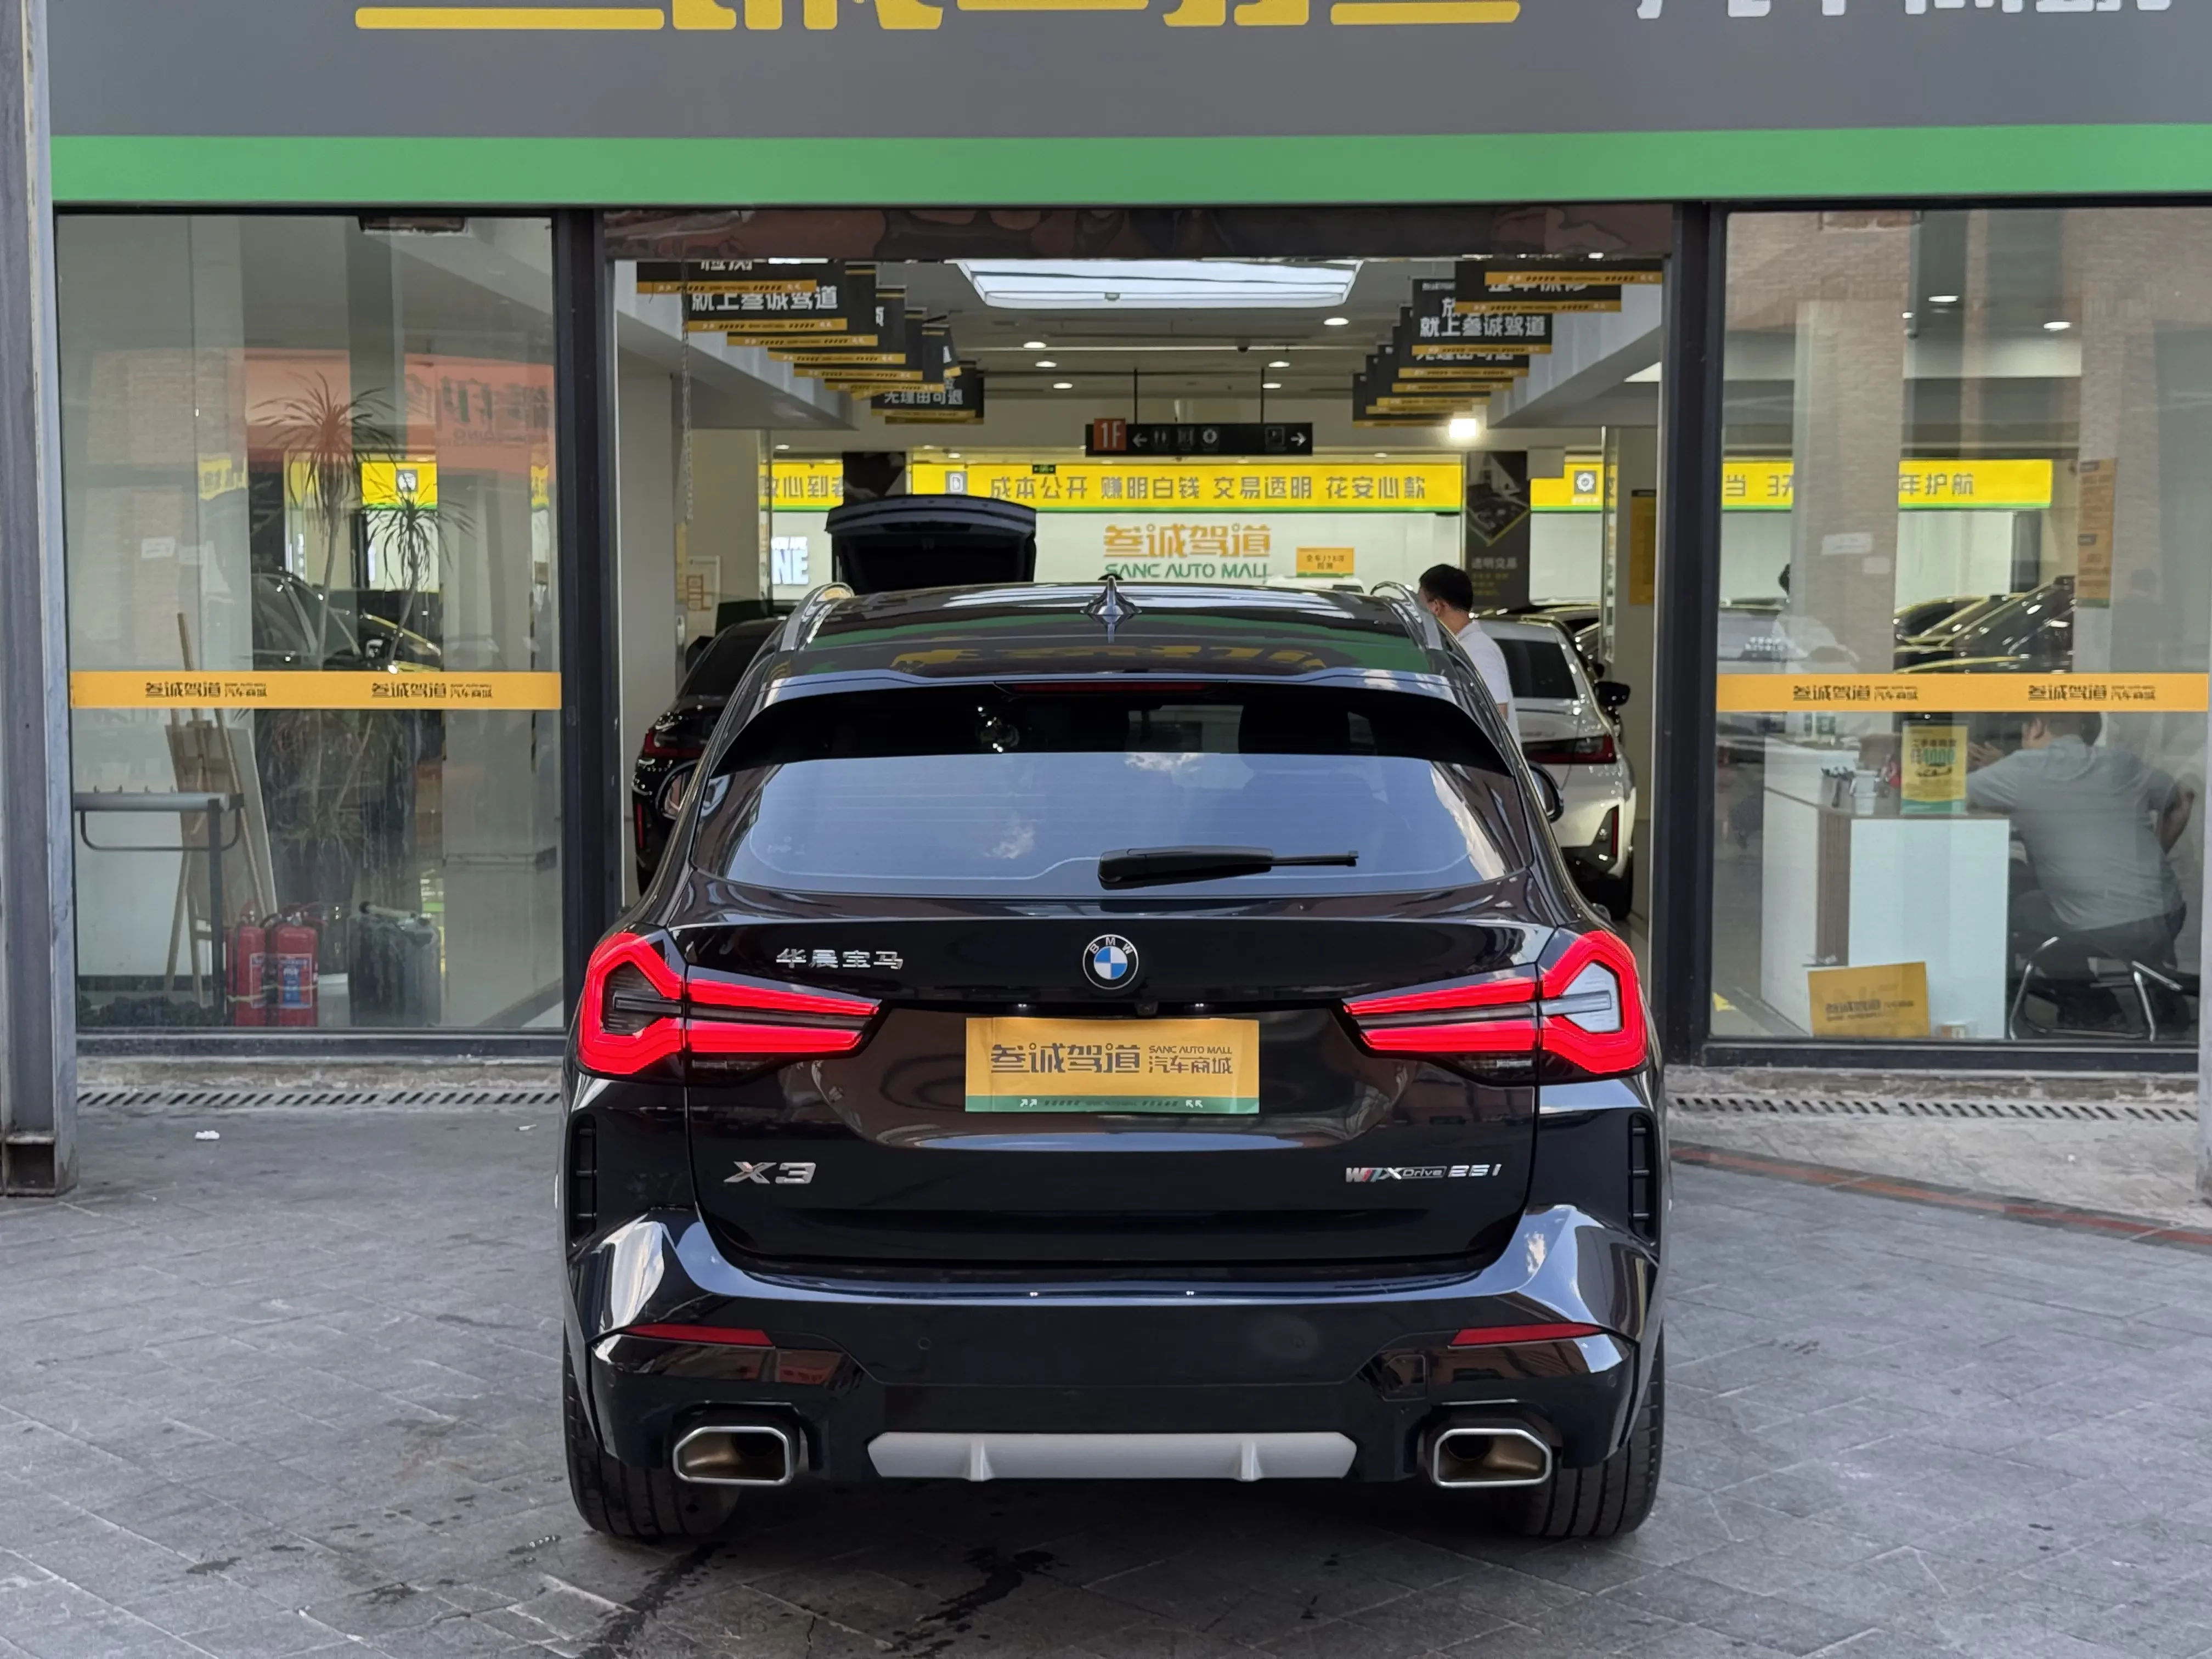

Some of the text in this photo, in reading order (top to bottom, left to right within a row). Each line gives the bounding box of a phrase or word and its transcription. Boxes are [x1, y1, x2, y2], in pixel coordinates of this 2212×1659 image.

[1419, 315, 1546, 337] 就上叁诚驾道
[1101, 422, 1121, 448] 1F
[990, 476, 1088, 499] 成本公开
[1101, 476, 1200, 500] 赚明白钱
[1213, 476, 1312, 500] 交易透明
[1103, 523, 1271, 558] 叁诚驾道
[1105, 563, 1161, 578] SANC
[1164, 563, 1215, 579] AUTO
[1089, 936, 1134, 955] BMW
[776, 948, 904, 970] 华晨宝马
[991, 1042, 1141, 1074] 叁诚驾道
[1149, 1045, 1233, 1054] SANC AUTO MALL
[1149, 1055, 1233, 1074] 汽车商城
[723, 1160, 816, 1184] X3
